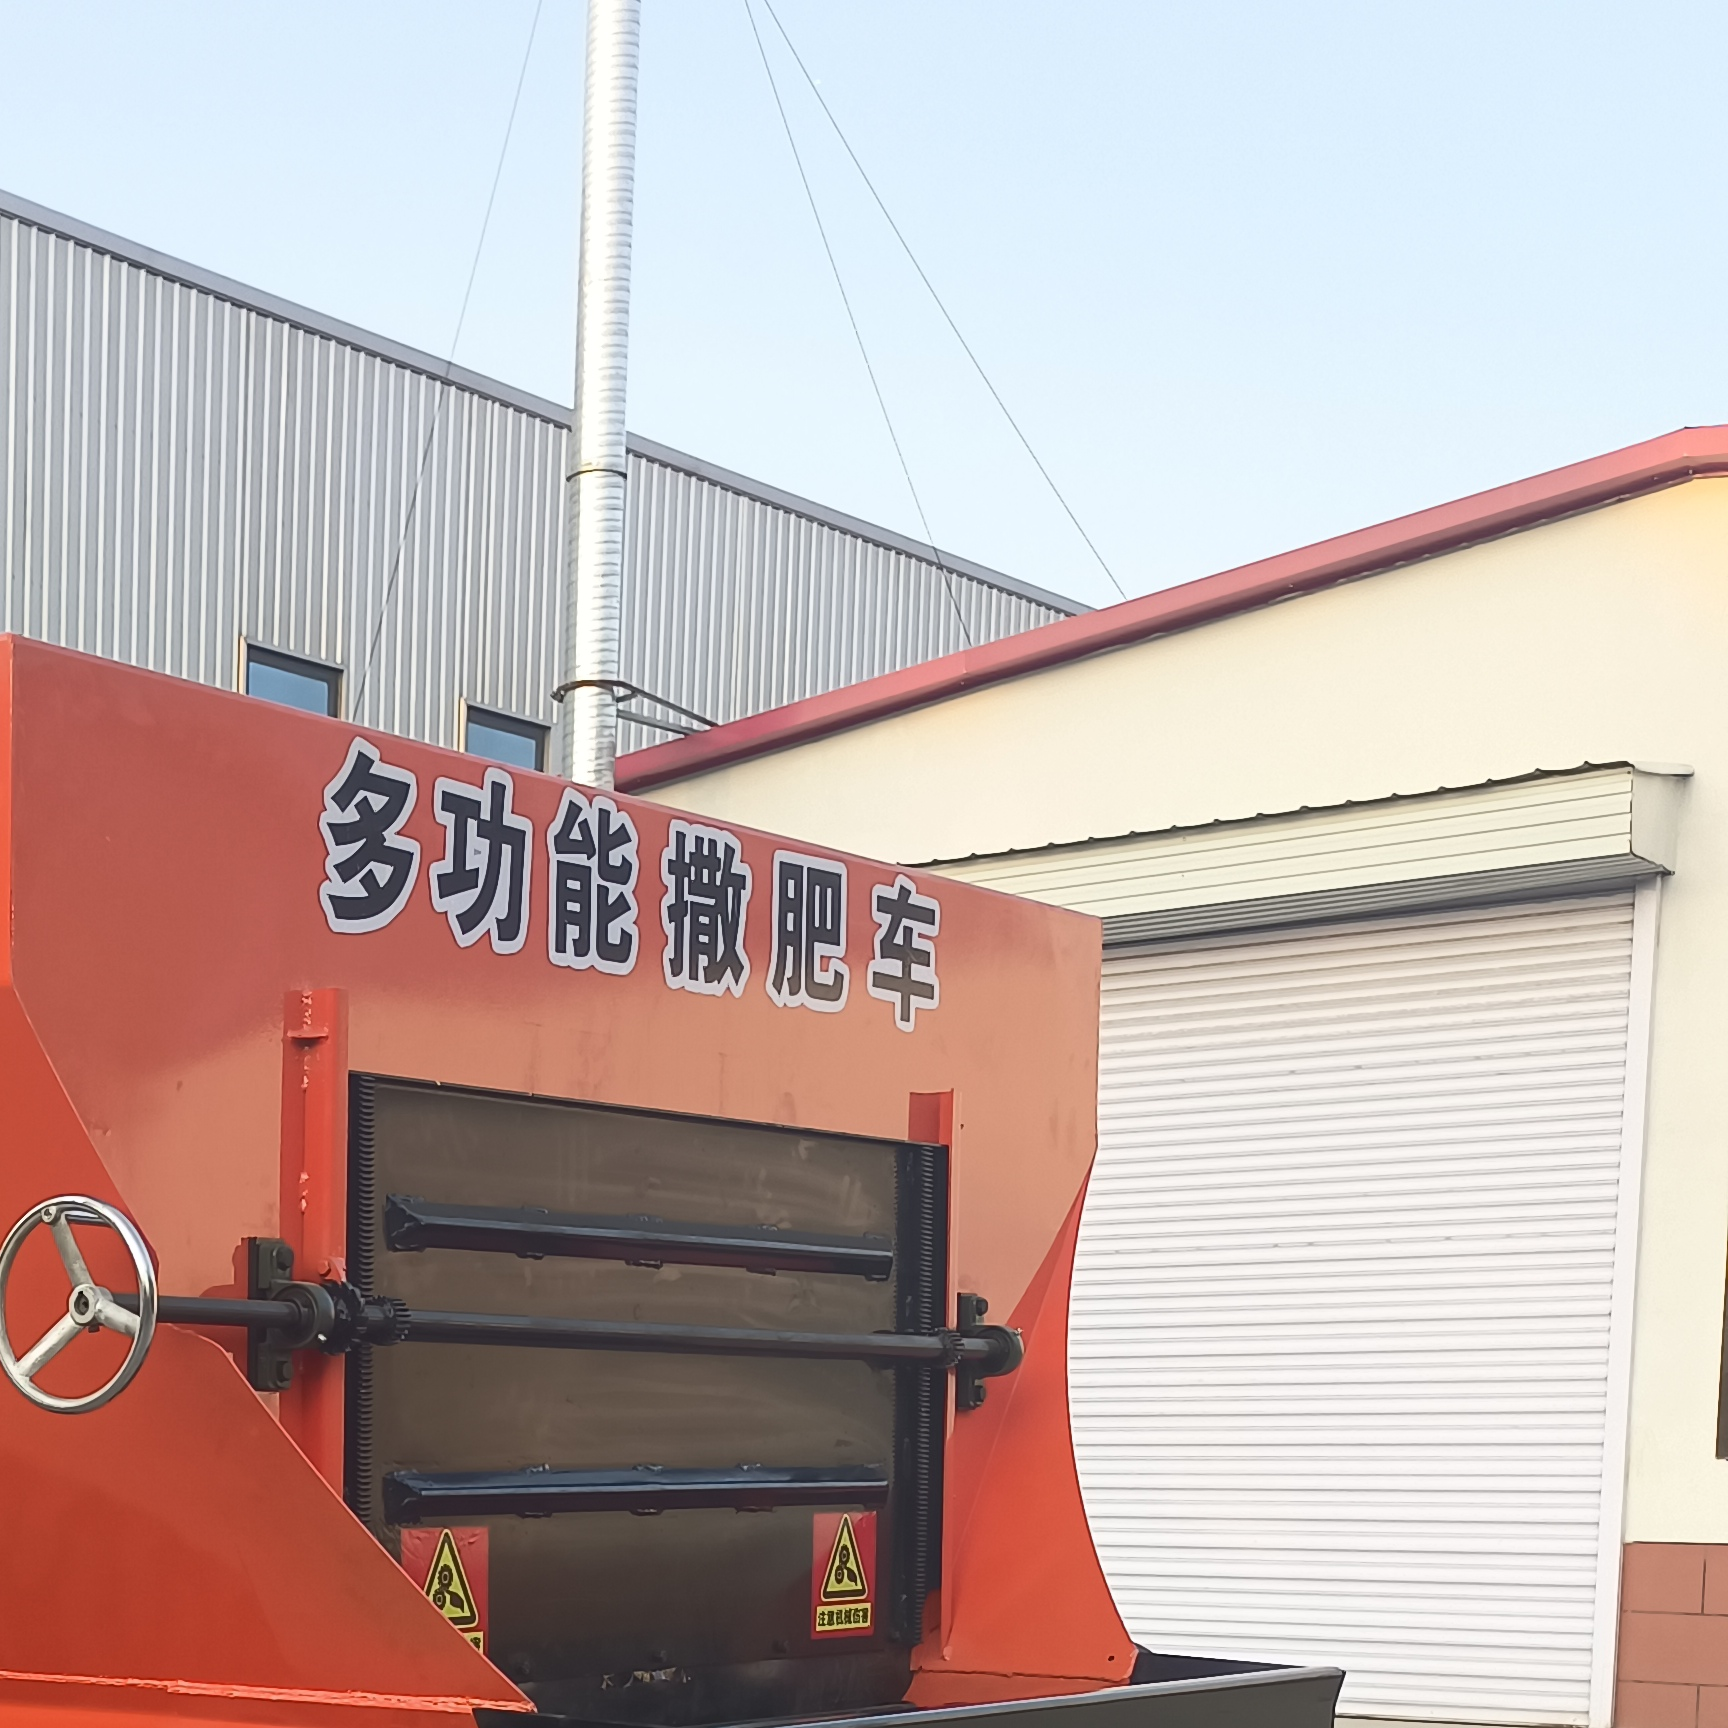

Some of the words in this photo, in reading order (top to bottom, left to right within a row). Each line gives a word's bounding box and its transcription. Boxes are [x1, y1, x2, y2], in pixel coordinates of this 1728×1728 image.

[323, 745, 937, 1027] 多功能撒肥车
